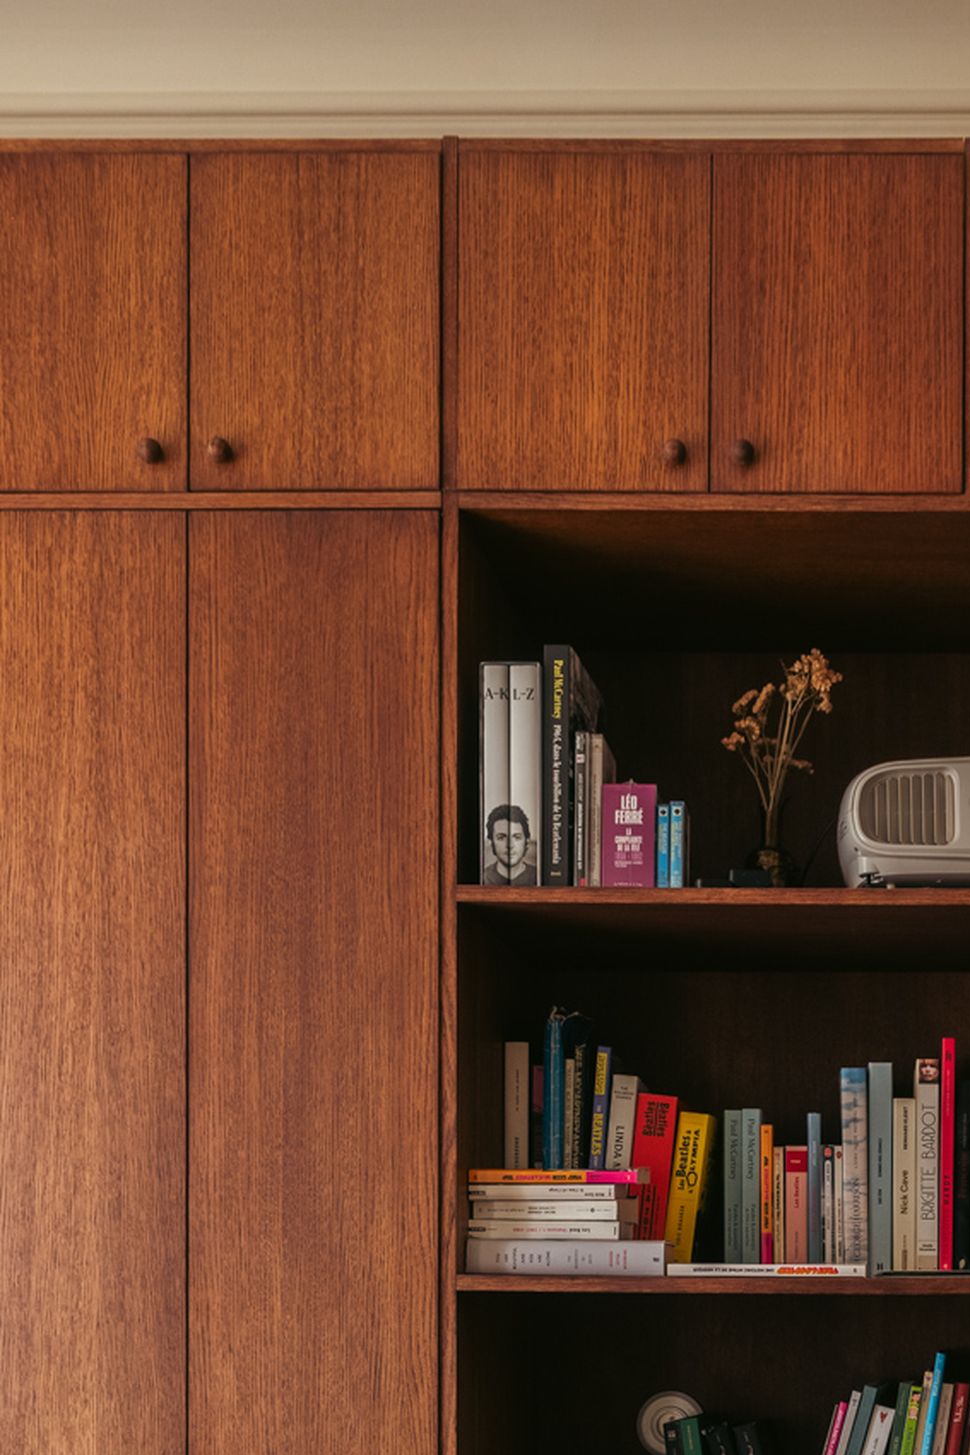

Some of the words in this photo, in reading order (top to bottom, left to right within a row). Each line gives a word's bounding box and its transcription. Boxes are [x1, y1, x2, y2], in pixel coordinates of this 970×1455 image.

[553, 659, 563, 676] Paul
[513, 687, 535, 701] L-Z
[551, 678, 563, 719] McCartney
[621, 793, 638, 810] LÉO
[615, 808, 643, 825] FERRÉ
[729, 1119, 738, 1136] Paul
[747, 1118, 755, 1136] Paul
[921, 1103, 936, 1159] BARDOT
[613, 1125, 625, 1159] LINDA
[675, 1135, 692, 1179] Beatles
[728, 1138, 738, 1180] McCartney
[745, 1138, 755, 1180] McCartney
[899, 1169, 907, 1192] Cave
[899, 1194, 907, 1214] Nick
[920, 1167, 936, 1220] BRIGITTE
